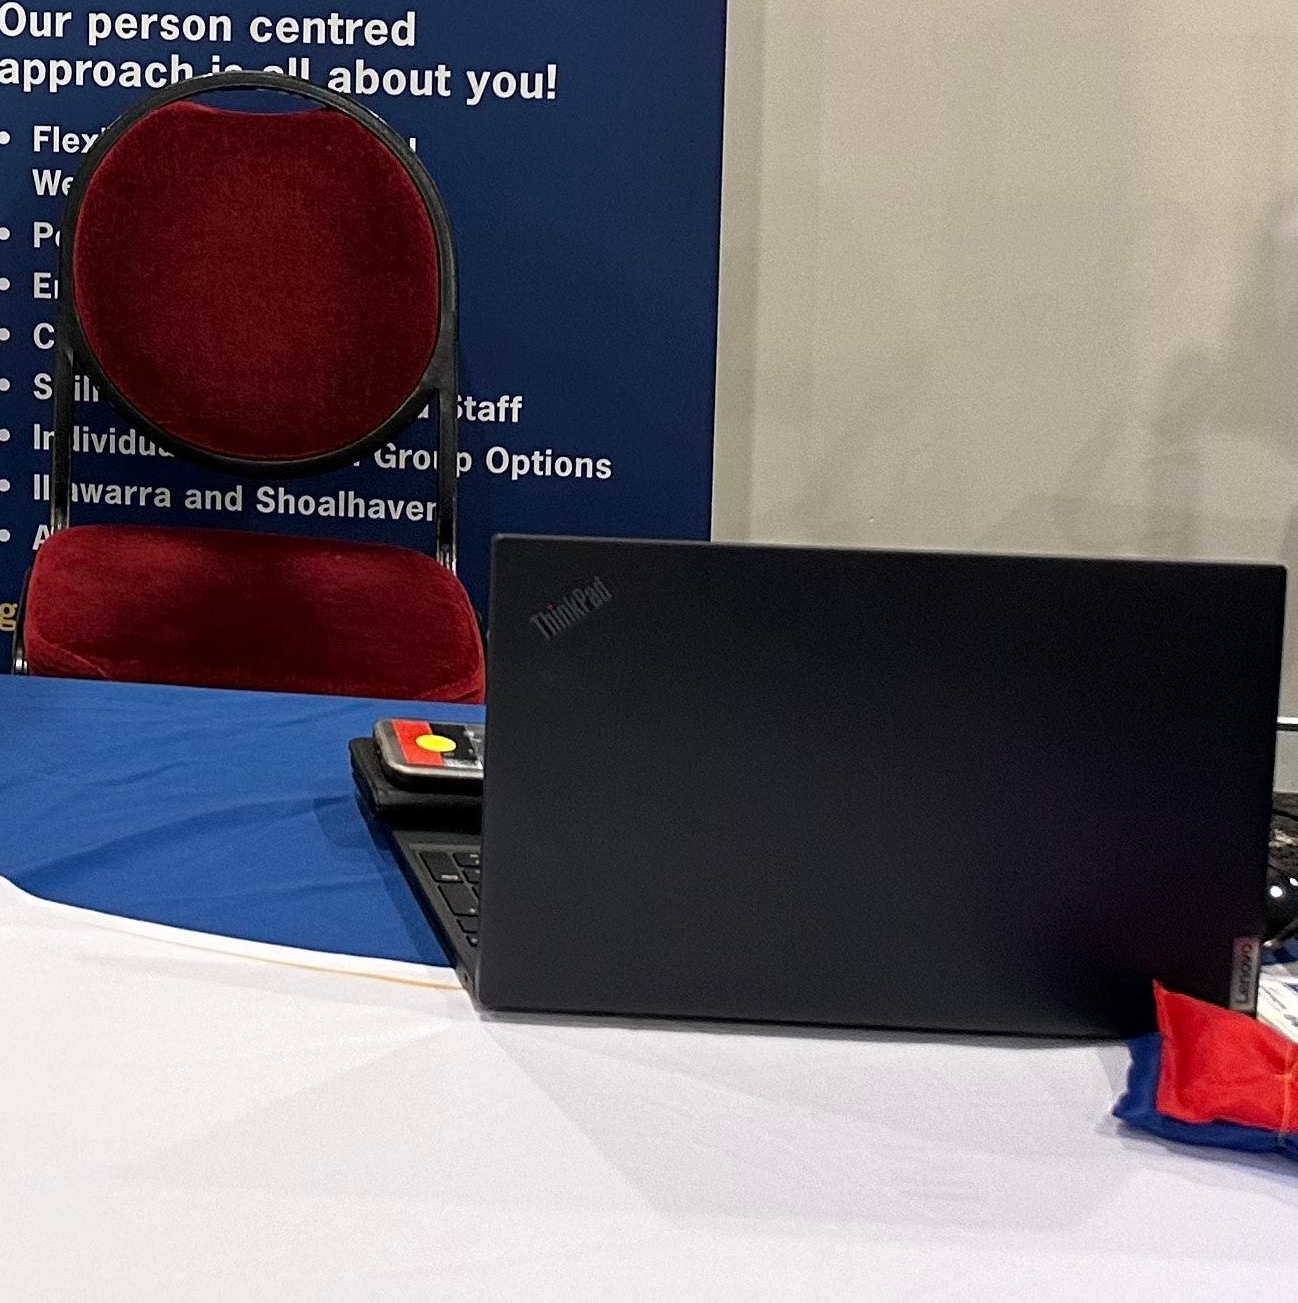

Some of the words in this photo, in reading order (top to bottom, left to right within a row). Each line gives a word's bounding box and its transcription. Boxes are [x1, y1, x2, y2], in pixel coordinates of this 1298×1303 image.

[87, 11, 232, 47] person
[249, 11, 416, 47] centred
[328, 63, 452, 98] about
[465, 64, 558, 106] you!
[486, 446, 612, 480] Options
[185, 485, 243, 511] and
[530, 576, 612, 640] ThinkPad
[1236, 942, 1253, 1004] Lenovo
